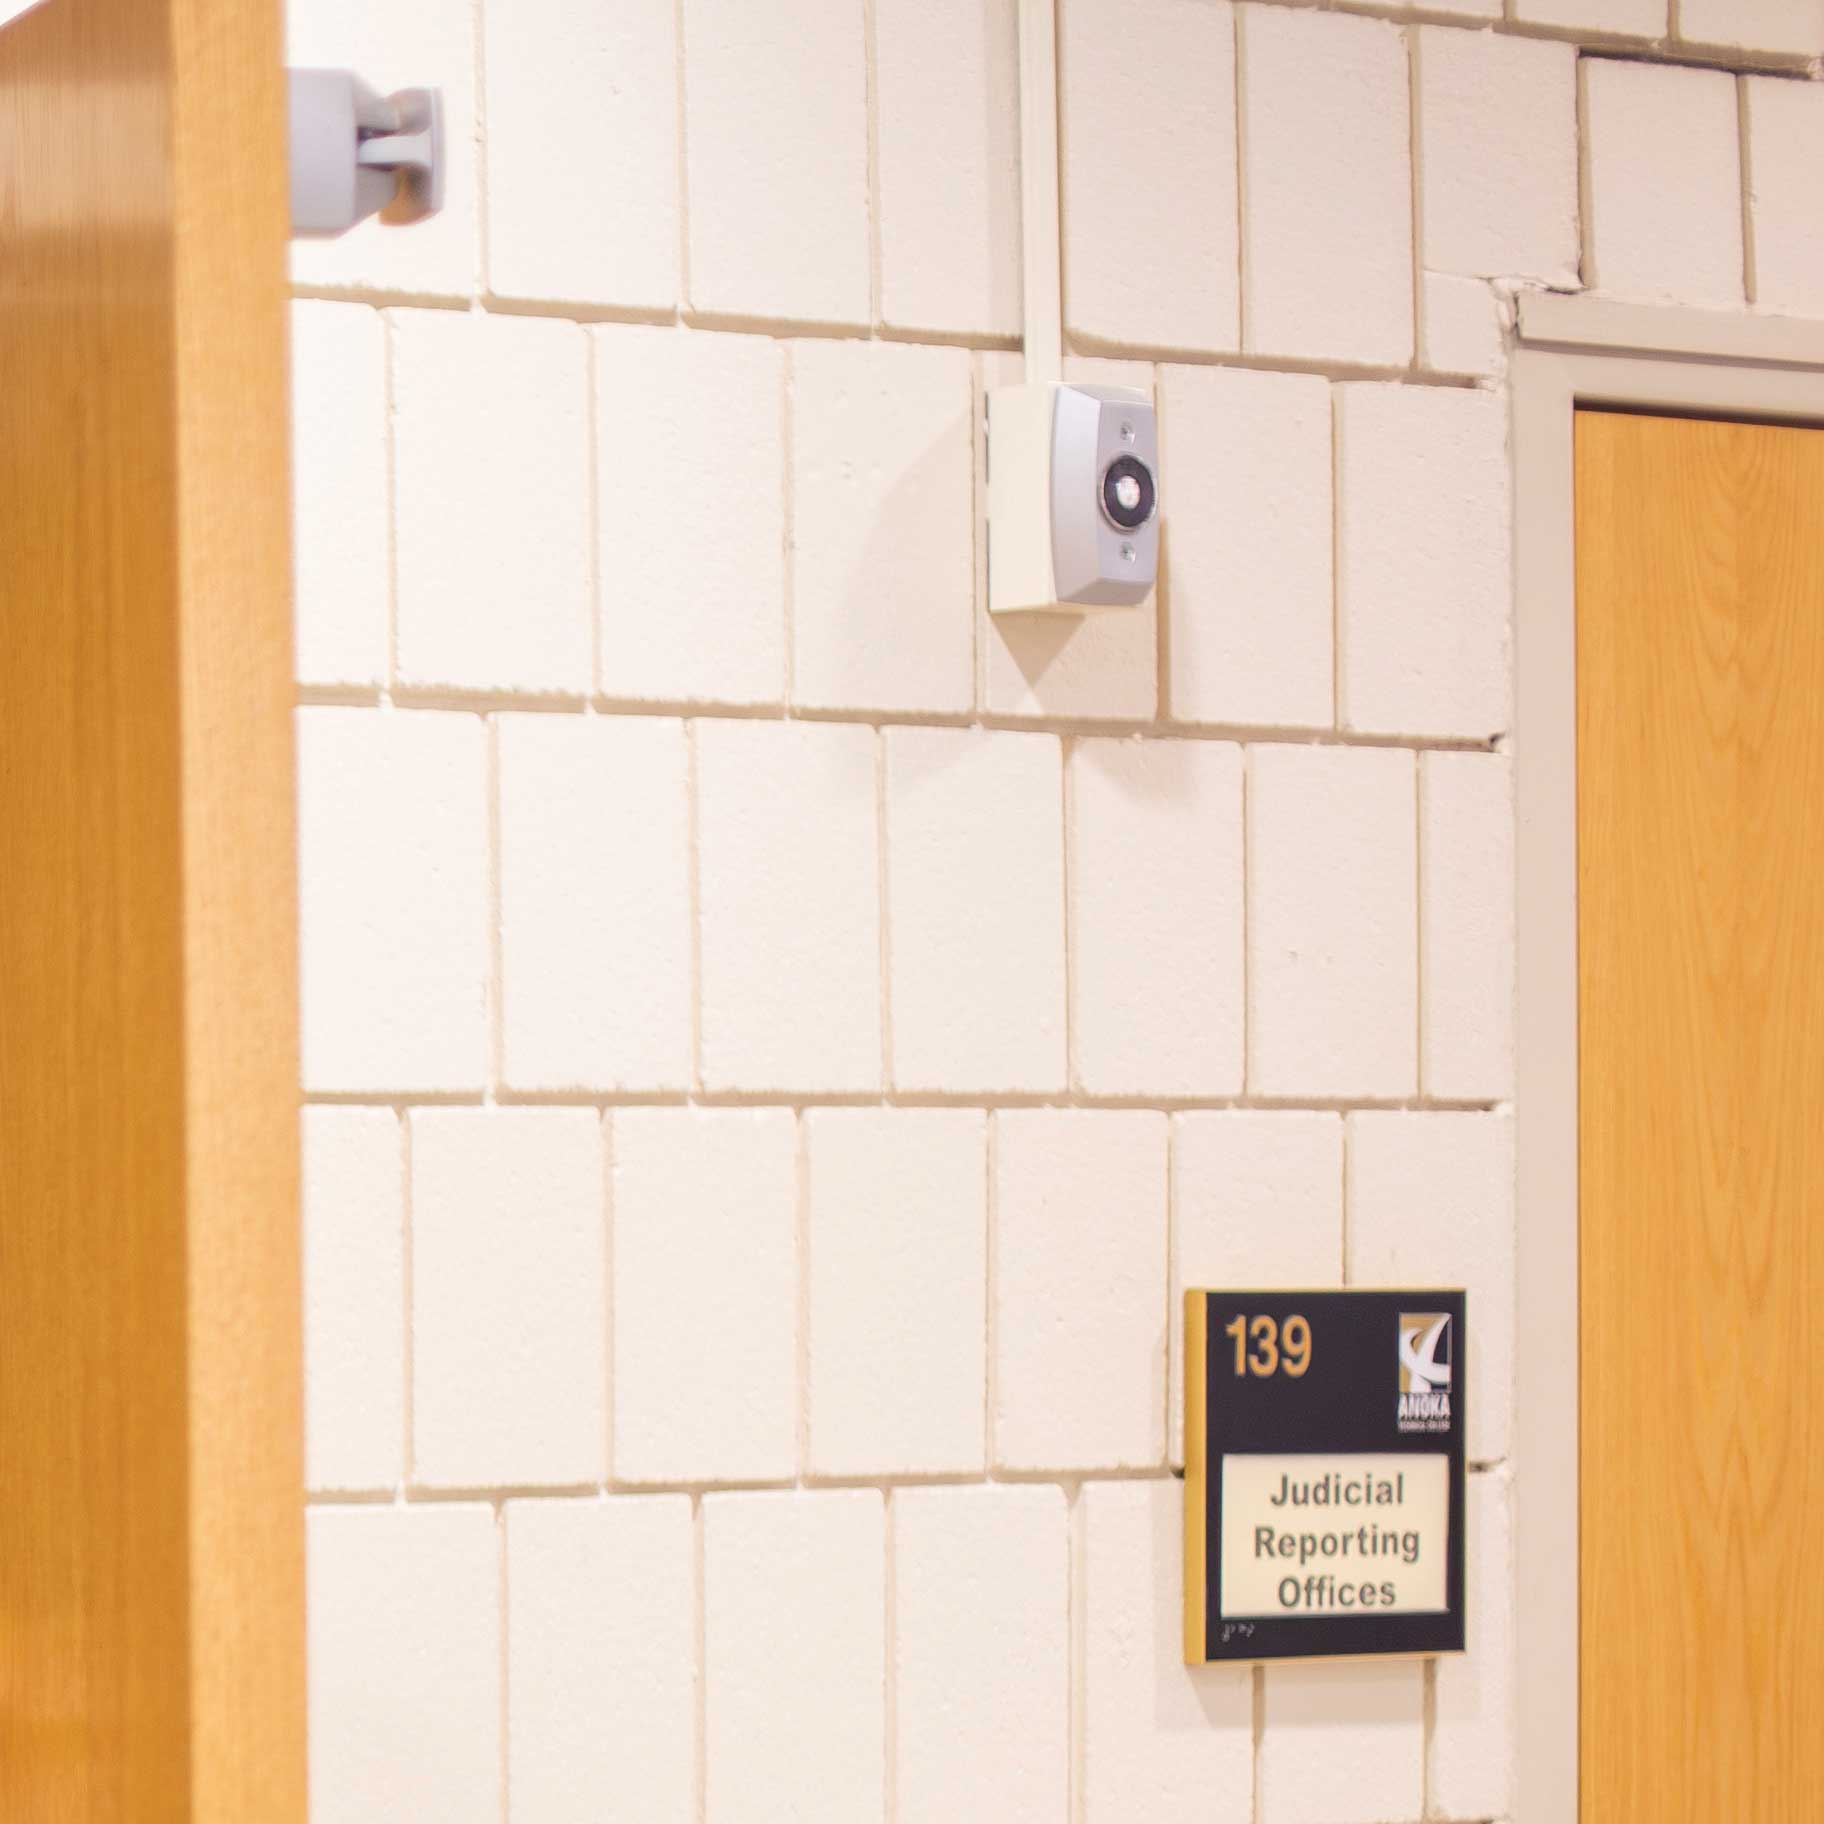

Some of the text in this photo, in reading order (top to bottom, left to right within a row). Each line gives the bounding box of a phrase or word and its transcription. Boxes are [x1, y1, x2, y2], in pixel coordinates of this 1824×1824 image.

[1225, 1313, 1313, 1378] 139
[1270, 1472, 1404, 1508] Judicial
[1253, 1523, 1421, 1566] Reporting
[1278, 1575, 1396, 1609] Offices
